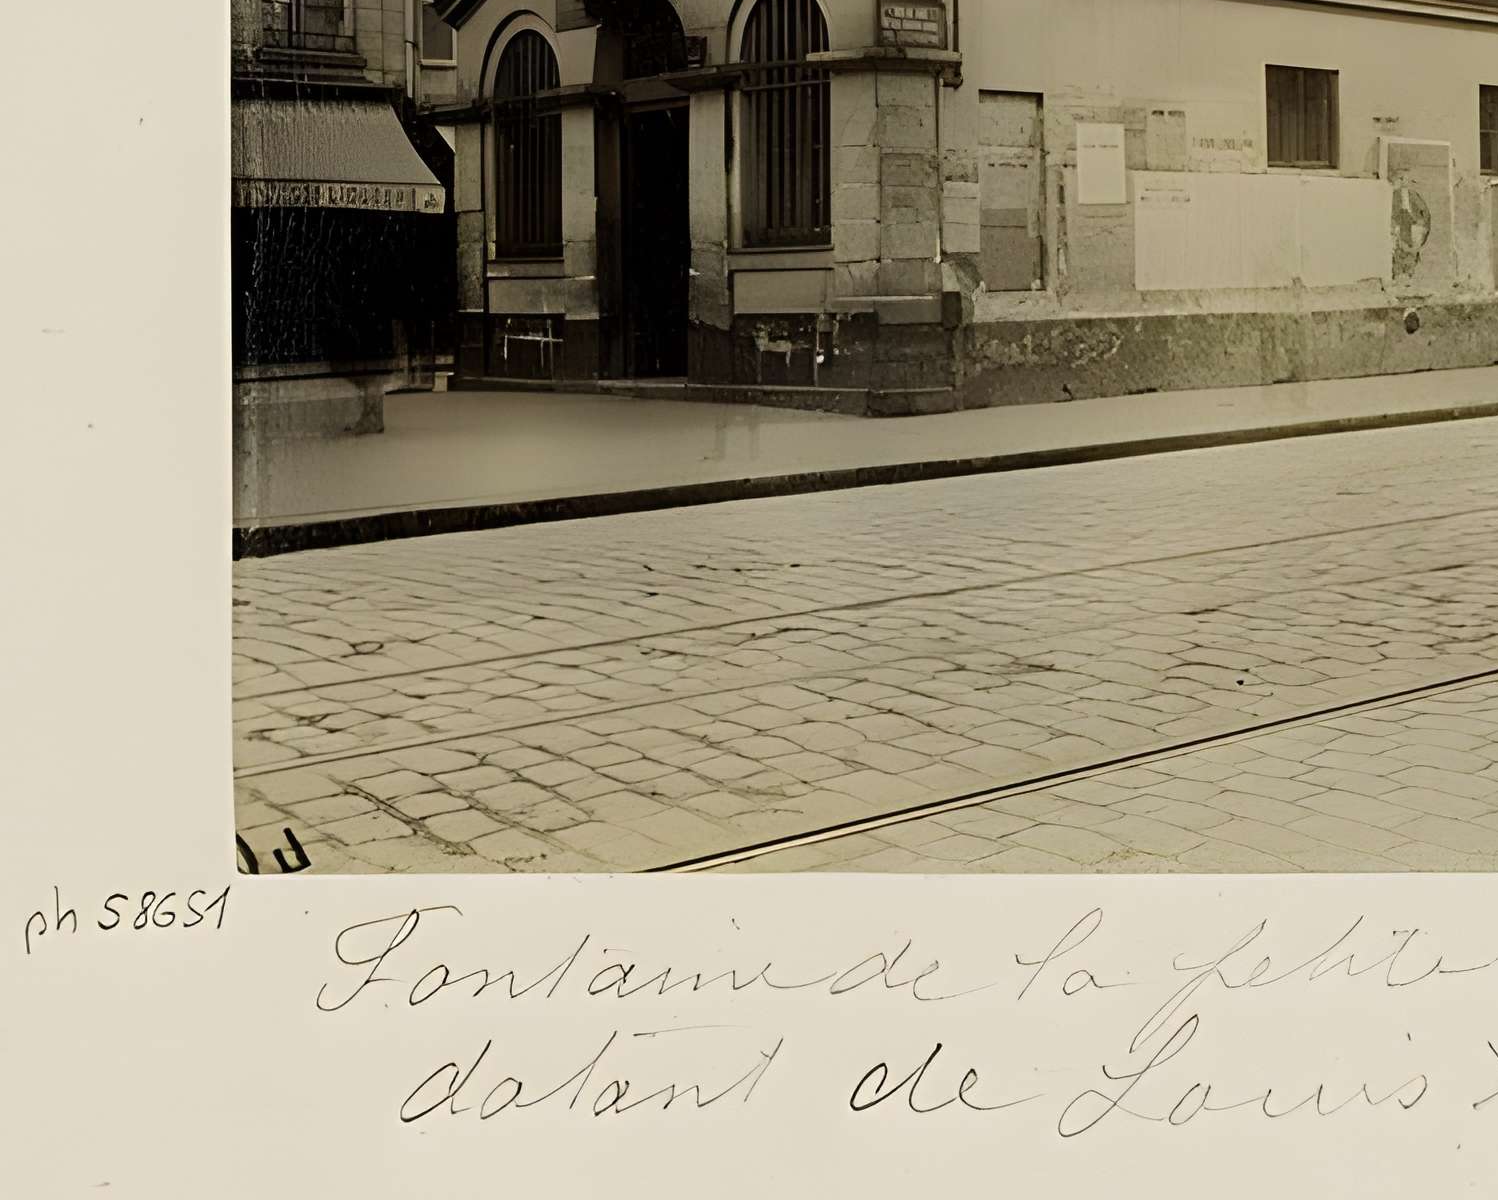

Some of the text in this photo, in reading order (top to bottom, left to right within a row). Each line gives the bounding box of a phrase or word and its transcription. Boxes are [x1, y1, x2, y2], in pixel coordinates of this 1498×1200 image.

[25, 884, 231, 955] ph 58651
[316, 905, 805, 1011] Fontaine
[830, 938, 998, 1000] de
[1014, 907, 1136, 1000] la
[400, 1026, 785, 1123] datant
[850, 1043, 1046, 1112] de
[1058, 1014, 1428, 1138] Louis
